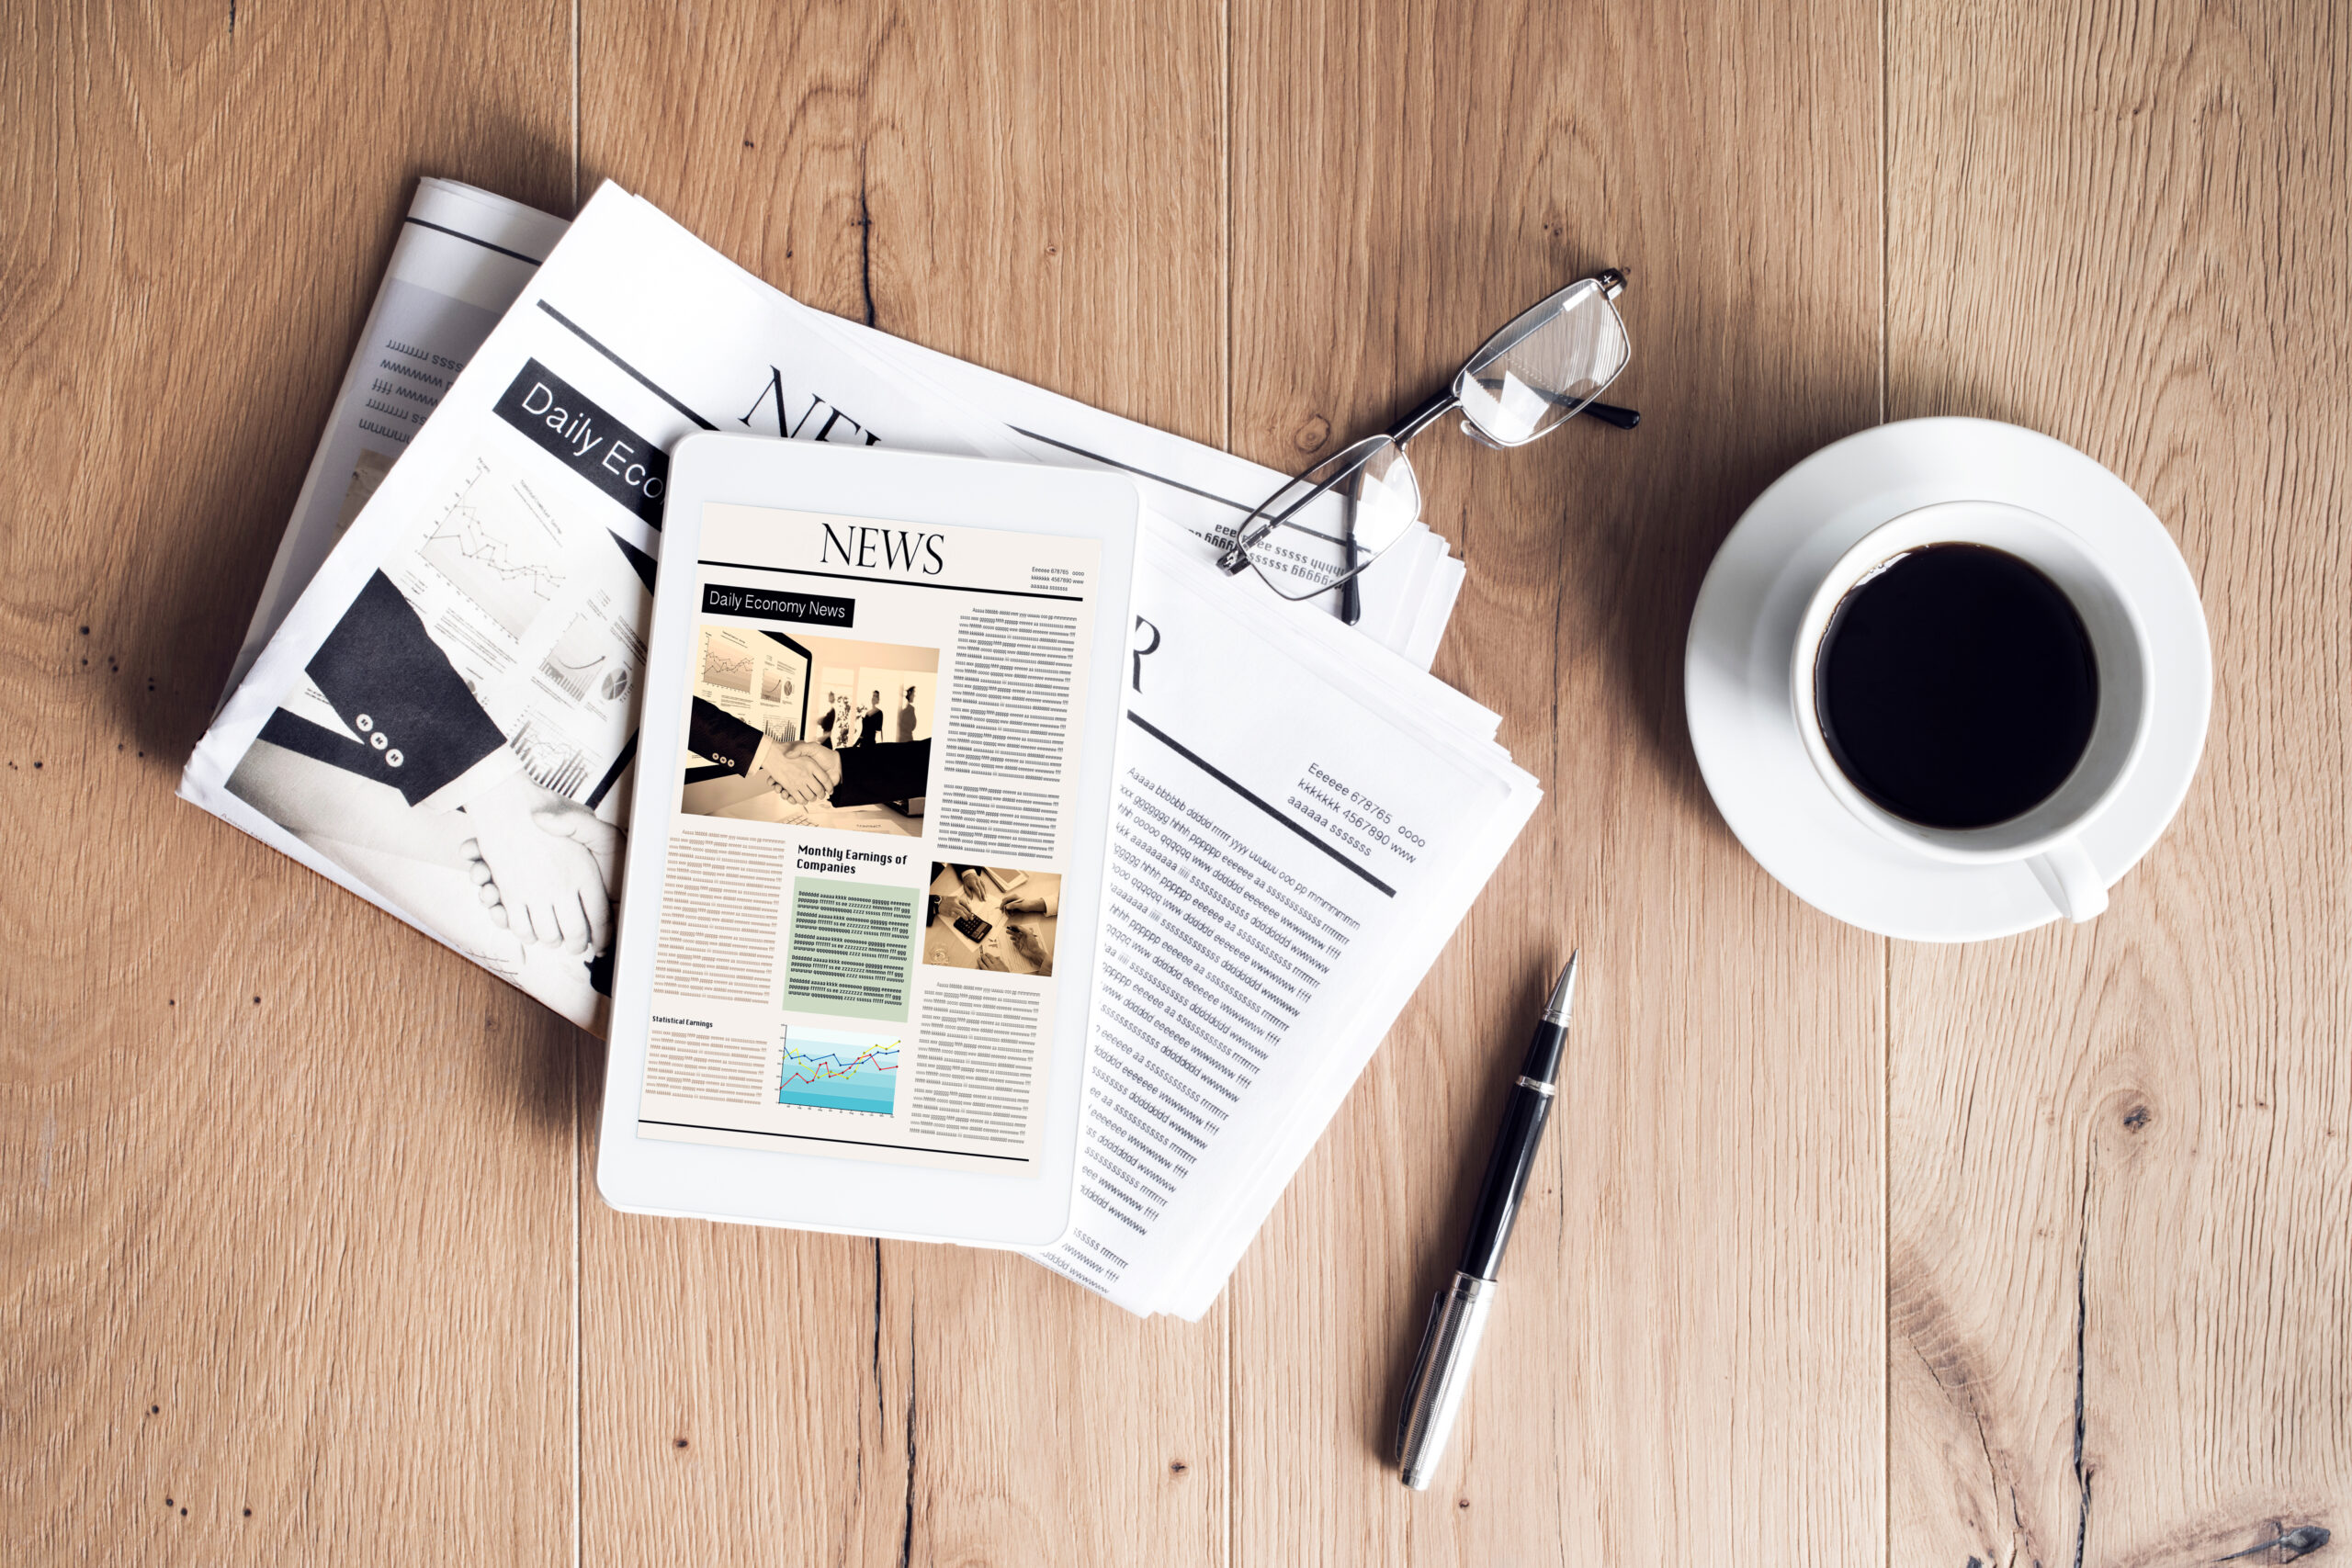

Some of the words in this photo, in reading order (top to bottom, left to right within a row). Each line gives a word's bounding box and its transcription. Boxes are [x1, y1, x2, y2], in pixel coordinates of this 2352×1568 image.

[522, 382, 601, 456] Daily
[602, 440, 665, 505] Eco
[820, 522, 944, 576] NEWS
[709, 591, 741, 610] Daily
[745, 594, 806, 616] Economy
[808, 601, 844, 617] News
[1297, 778, 1340, 812] kkkkkkk
[1342, 809, 1390, 845] 4567890
[1390, 842, 1416, 863] www
[1307, 762, 1349, 795] Eeeeee
[1350, 791, 1392, 824] 678765
[1397, 825, 1425, 847] oooo
[1287, 795, 1328, 827] aaaaaa
[1329, 824, 1371, 856] sssssss
[797, 844, 842, 861] Monthly
[845, 849, 892, 865] Earnings
[894, 854, 908, 864] of
[797, 858, 855, 874] Companies
[1293, 882, 1307, 895] pp
[651, 1015, 684, 1024] Statistical
[685, 1019, 713, 1029] Earnings
